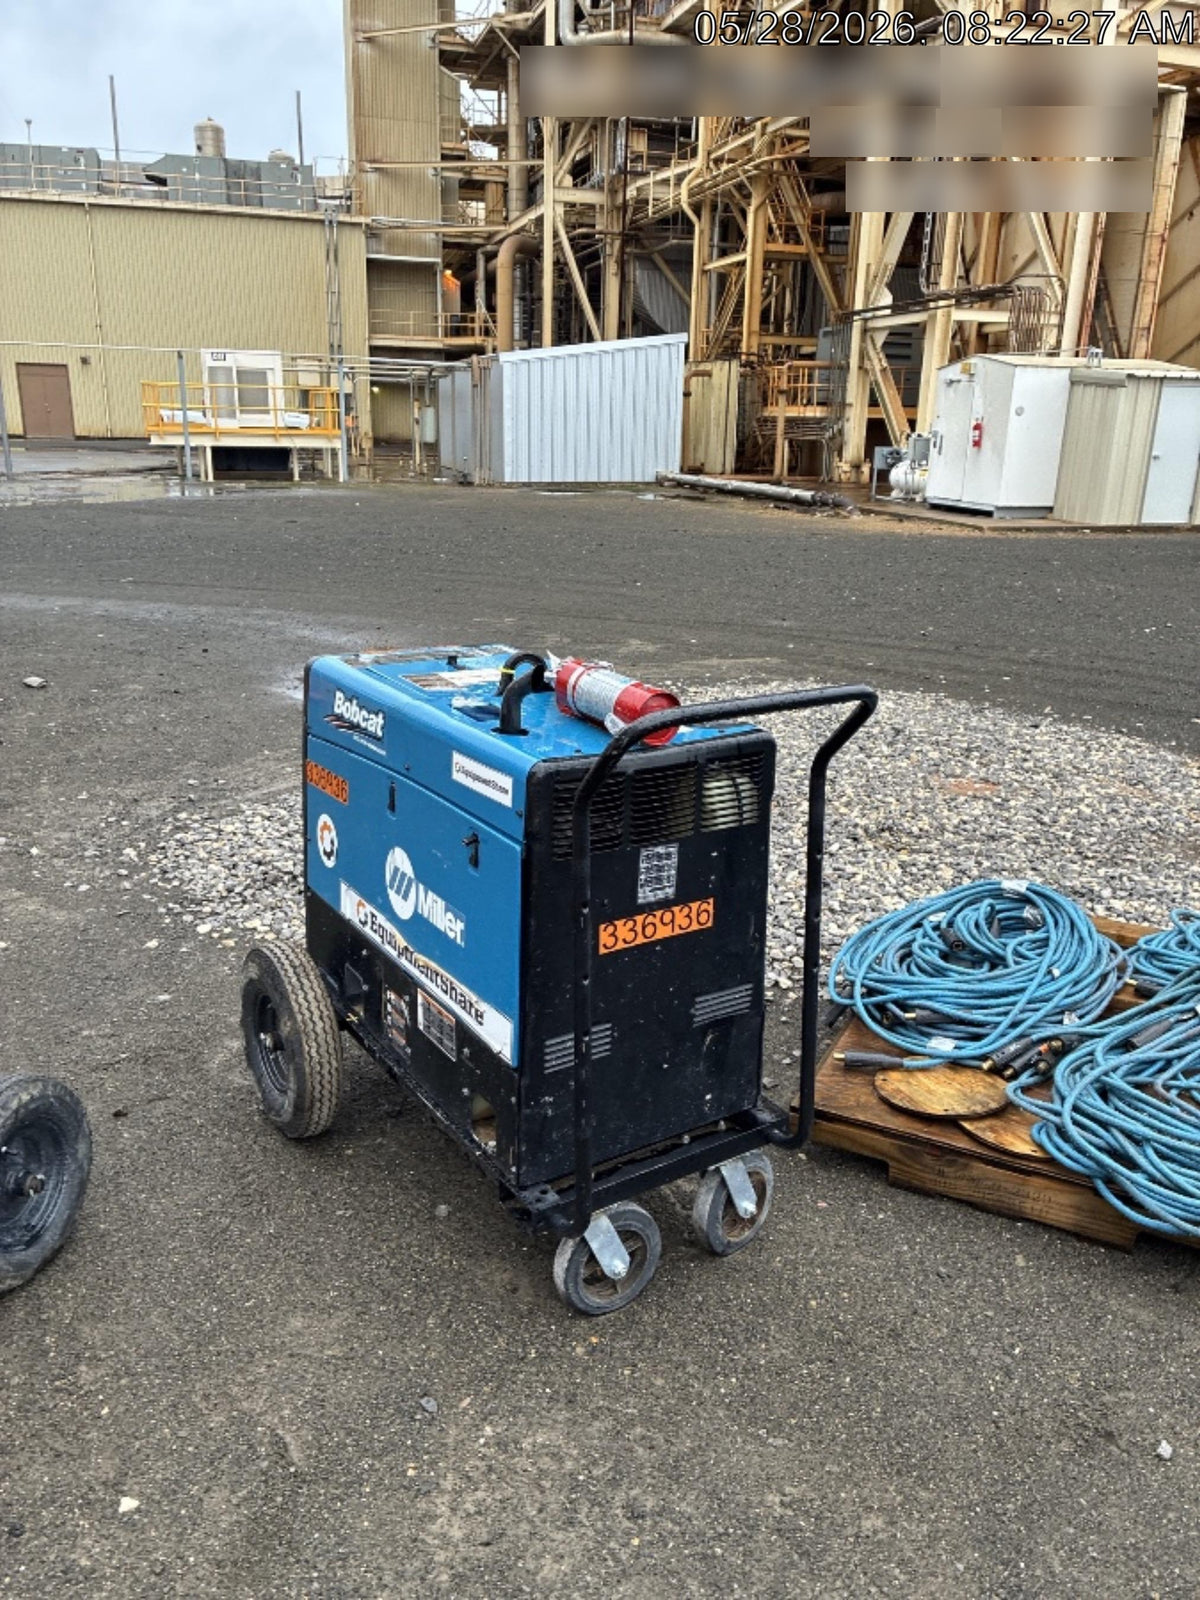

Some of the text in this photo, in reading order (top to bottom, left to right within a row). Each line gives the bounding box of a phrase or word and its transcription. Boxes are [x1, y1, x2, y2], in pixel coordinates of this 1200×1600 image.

[333, 689, 384, 738] Bobcat
[417, 882, 465, 947] Miller
[602, 900, 711, 950] 336936
